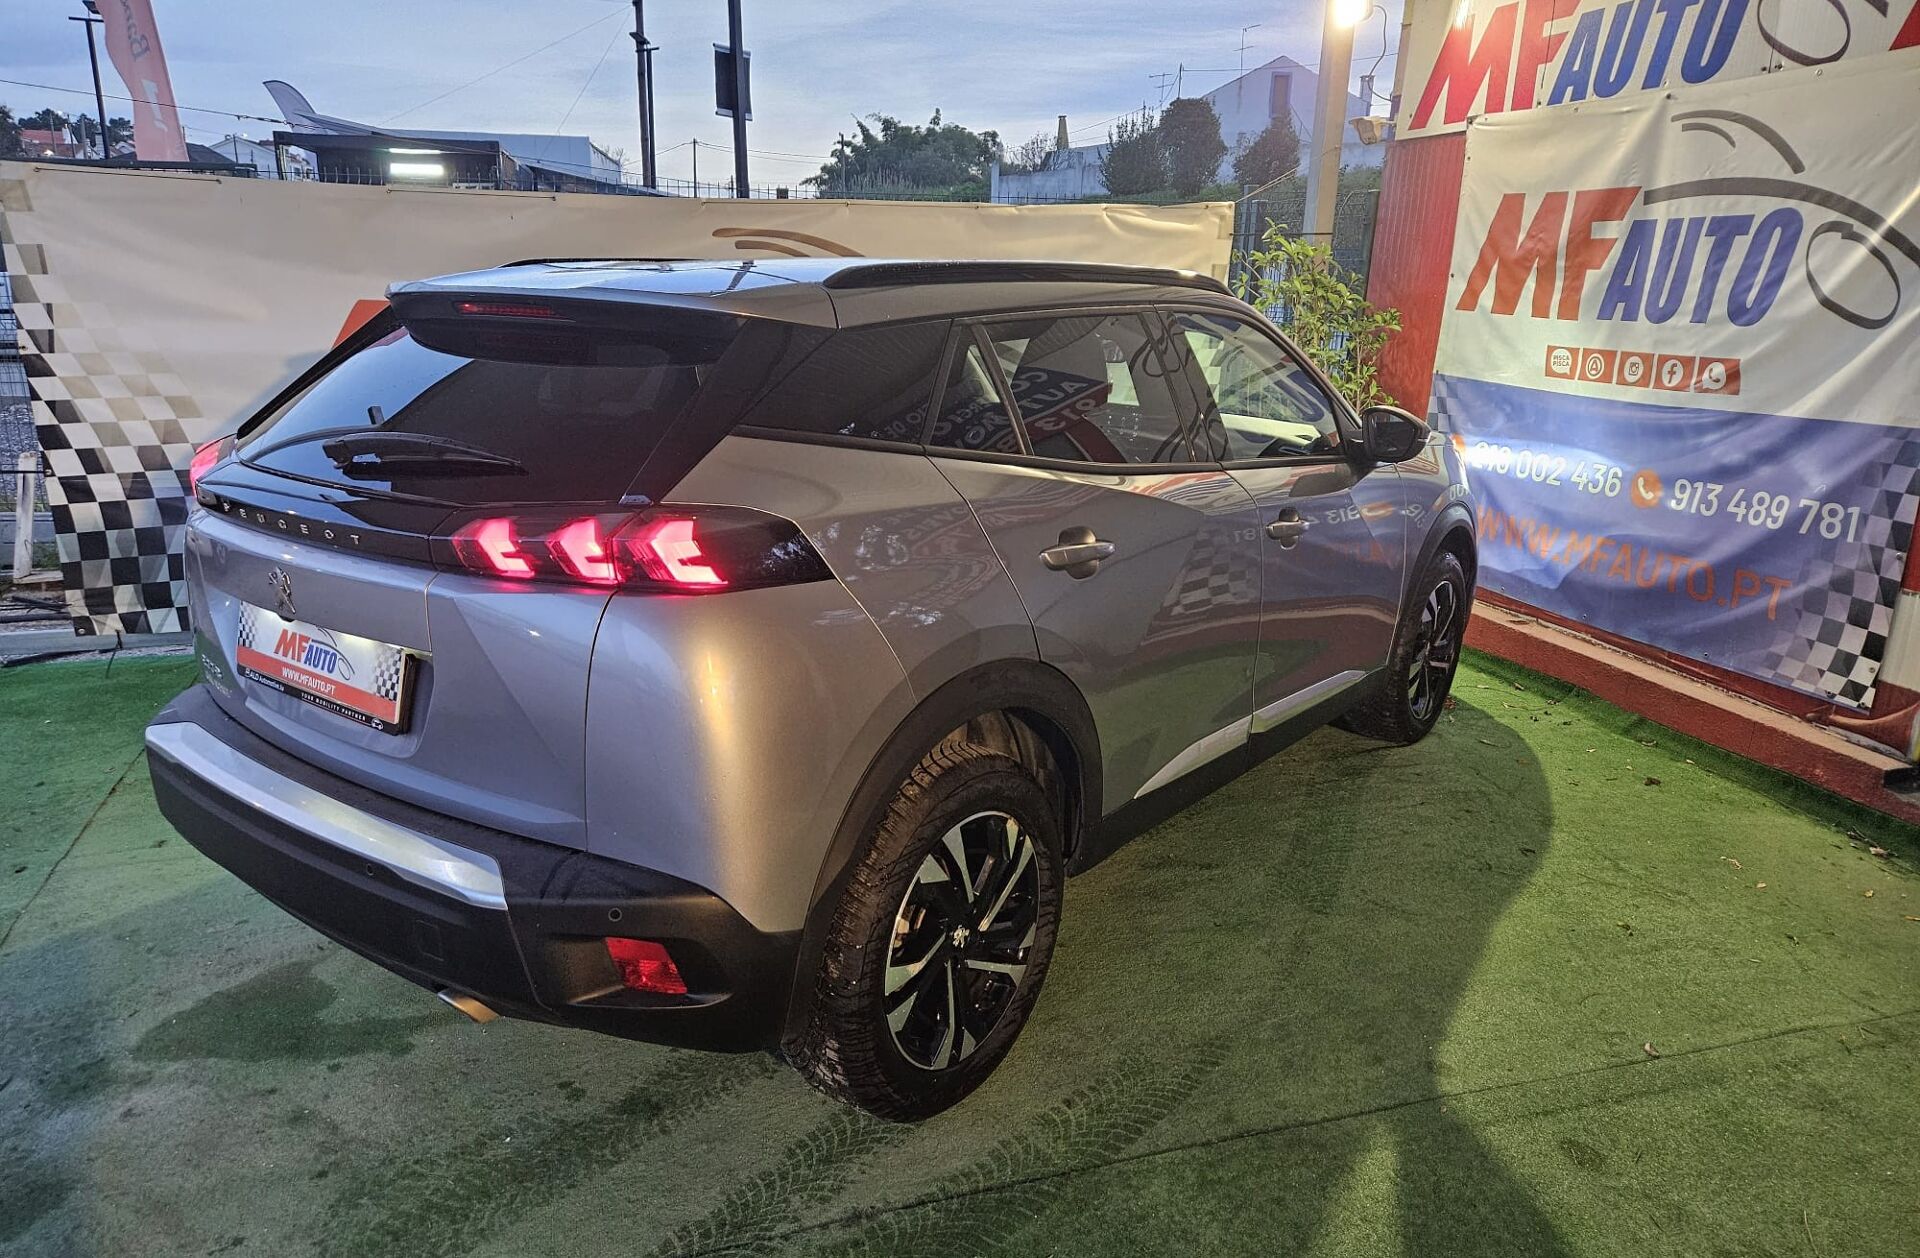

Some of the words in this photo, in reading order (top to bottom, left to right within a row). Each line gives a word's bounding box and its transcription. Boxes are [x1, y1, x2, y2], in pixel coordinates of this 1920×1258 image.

[1455, 186, 1804, 328] MFAUTO
[1515, 450, 1567, 486] 002
[1571, 461, 1623, 498] 436
[1670, 478, 1725, 517] 913
[1726, 487, 1790, 530] 489
[1798, 500, 1861, 543] 781
[222, 501, 360, 546] PEUGEOT
[273, 629, 337, 675] MFAUTO
[282, 666, 336, 696] WWW.MFAUTO.PT
